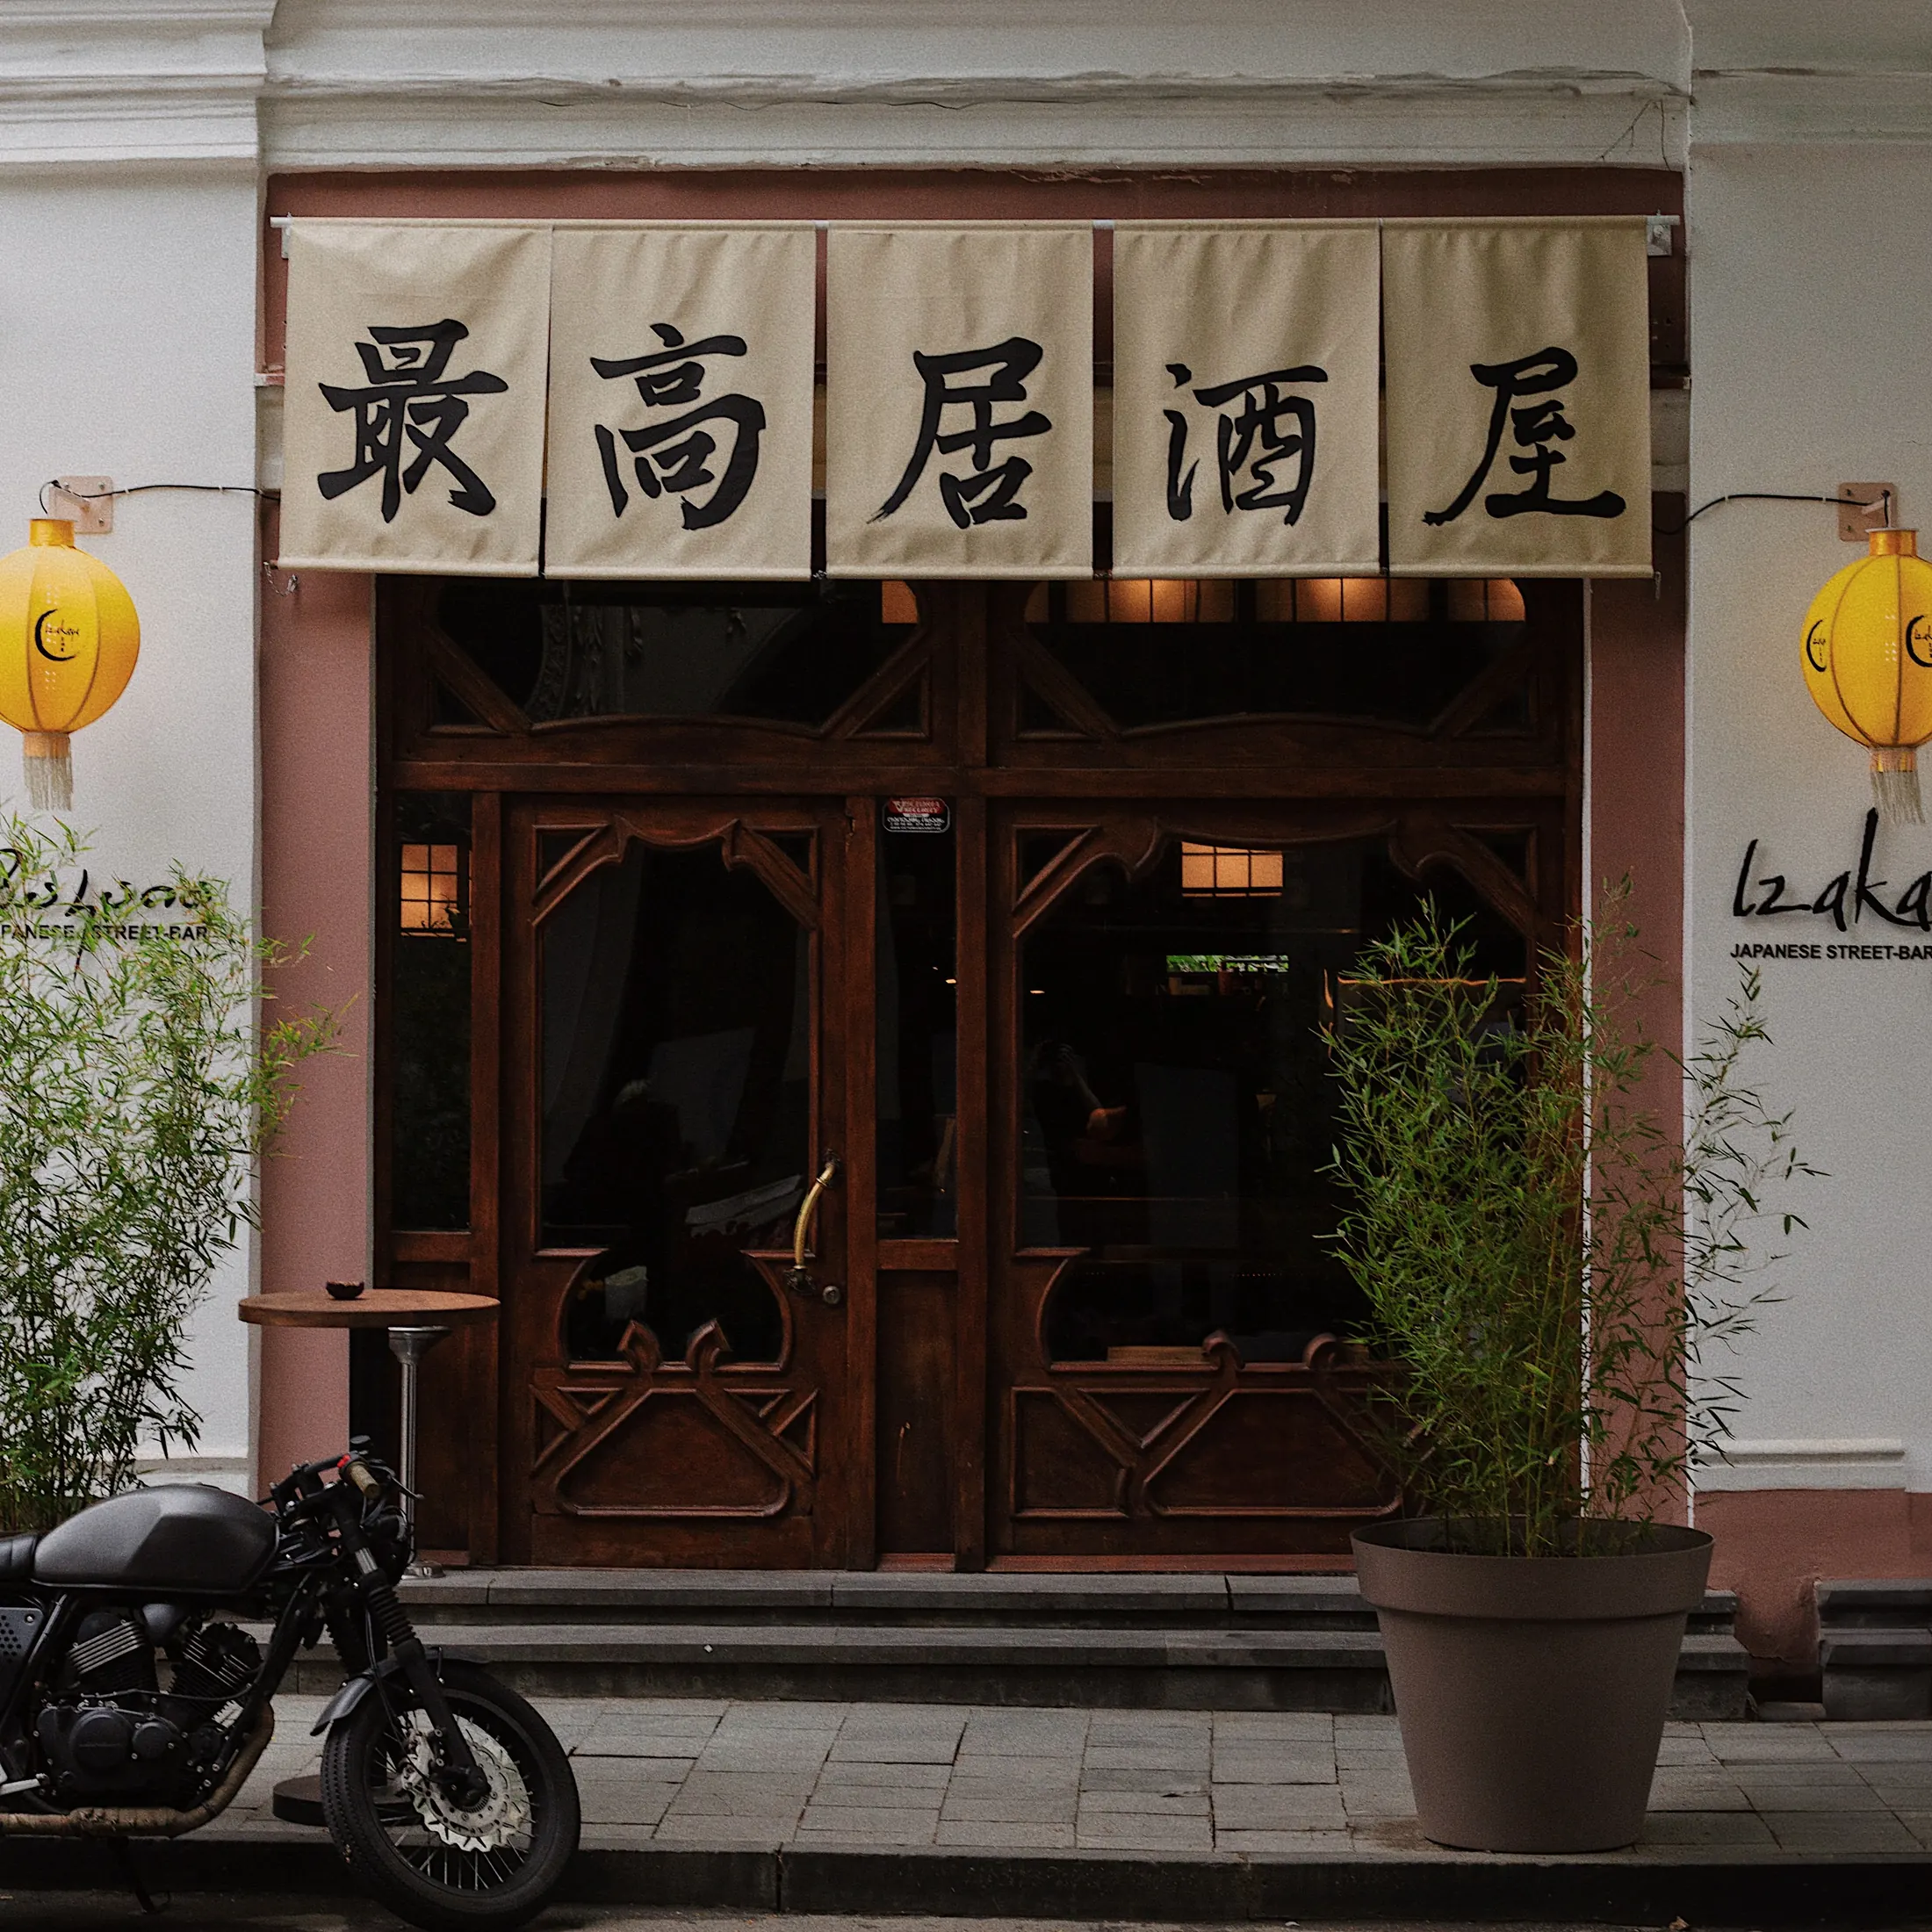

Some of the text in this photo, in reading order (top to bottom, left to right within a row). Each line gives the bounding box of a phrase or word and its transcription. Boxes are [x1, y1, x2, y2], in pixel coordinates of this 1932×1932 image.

[317, 319, 1626, 531] 最高居酒屋
[1733, 807, 1932, 932] Izaka
[1730, 943, 1932, 960] JAPANESE STREET-BAR
